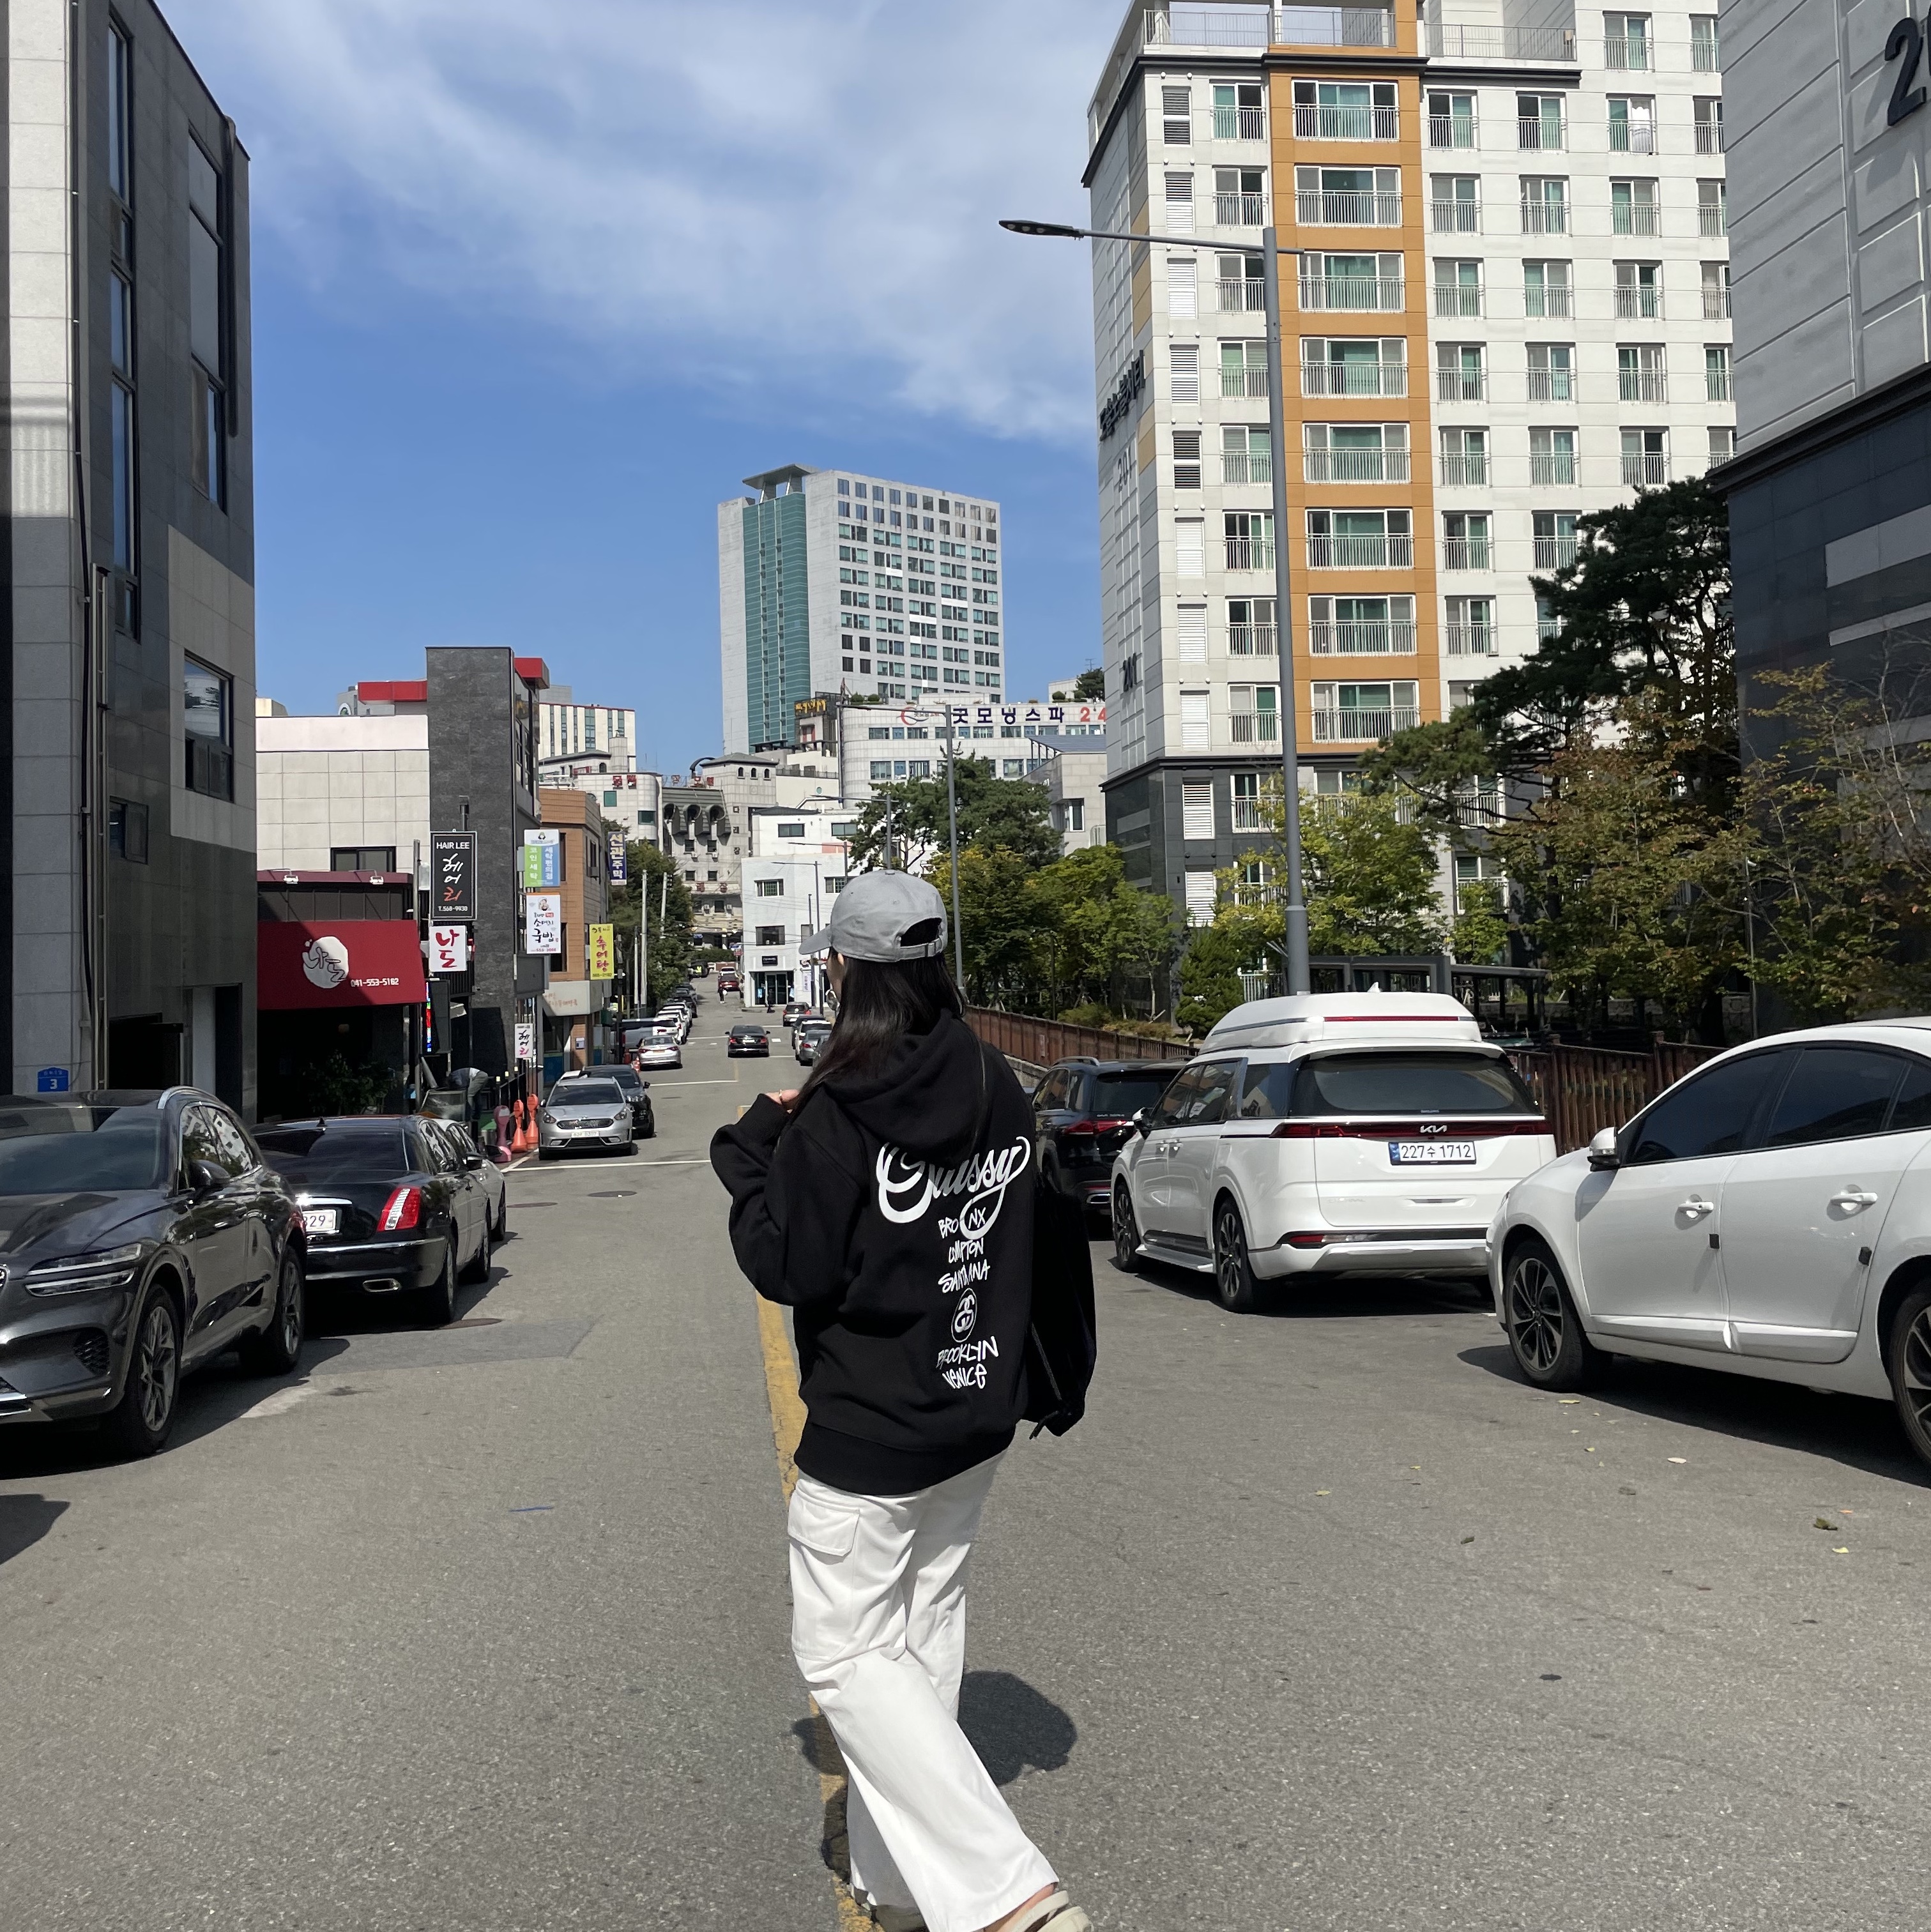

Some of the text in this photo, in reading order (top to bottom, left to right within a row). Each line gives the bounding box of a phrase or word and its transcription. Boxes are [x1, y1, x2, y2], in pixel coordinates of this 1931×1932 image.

[1885, 5, 1931, 126] 2
[953, 708, 1064, 725] 굿모닝스파
[529, 847, 538, 879] 코인세탁
[531, 928, 554, 943] 국밥
[596, 935, 609, 973] 추어탕
[50, 1079, 57, 1090] 3
[935, 1335, 999, 1370] BROOKLYN
